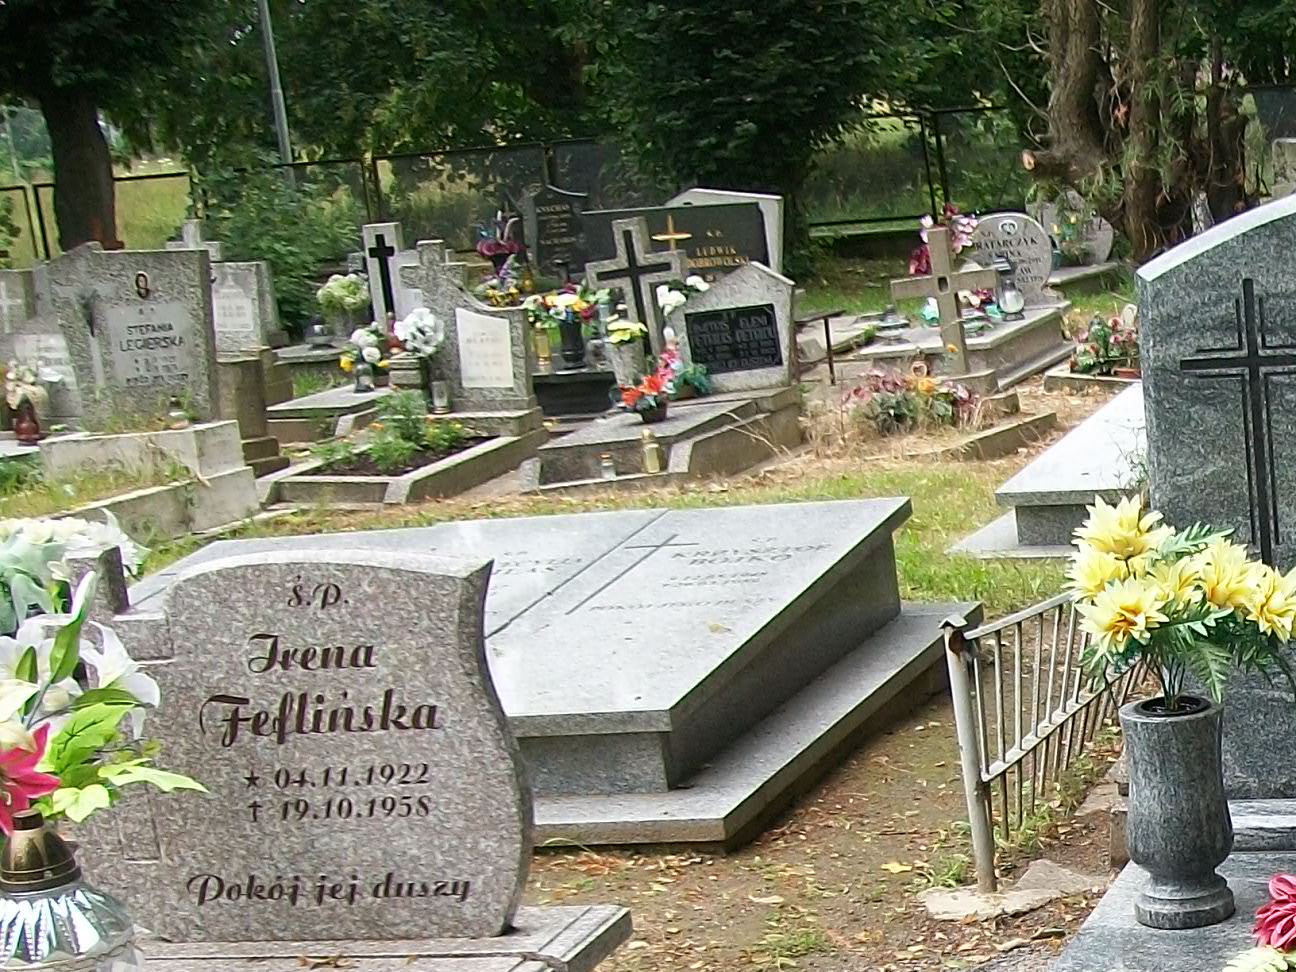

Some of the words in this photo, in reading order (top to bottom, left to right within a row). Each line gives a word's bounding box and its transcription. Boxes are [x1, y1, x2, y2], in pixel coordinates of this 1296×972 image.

[127, 322, 174, 336] STEFANIA
[248, 633, 376, 673] Irena
[274, 762, 430, 788] 04.11.1922
[281, 795, 431, 820] 19.10.1958
[187, 872, 300, 906] Pokój
[315, 873, 358, 906] jej
[373, 872, 471, 902] duszy
